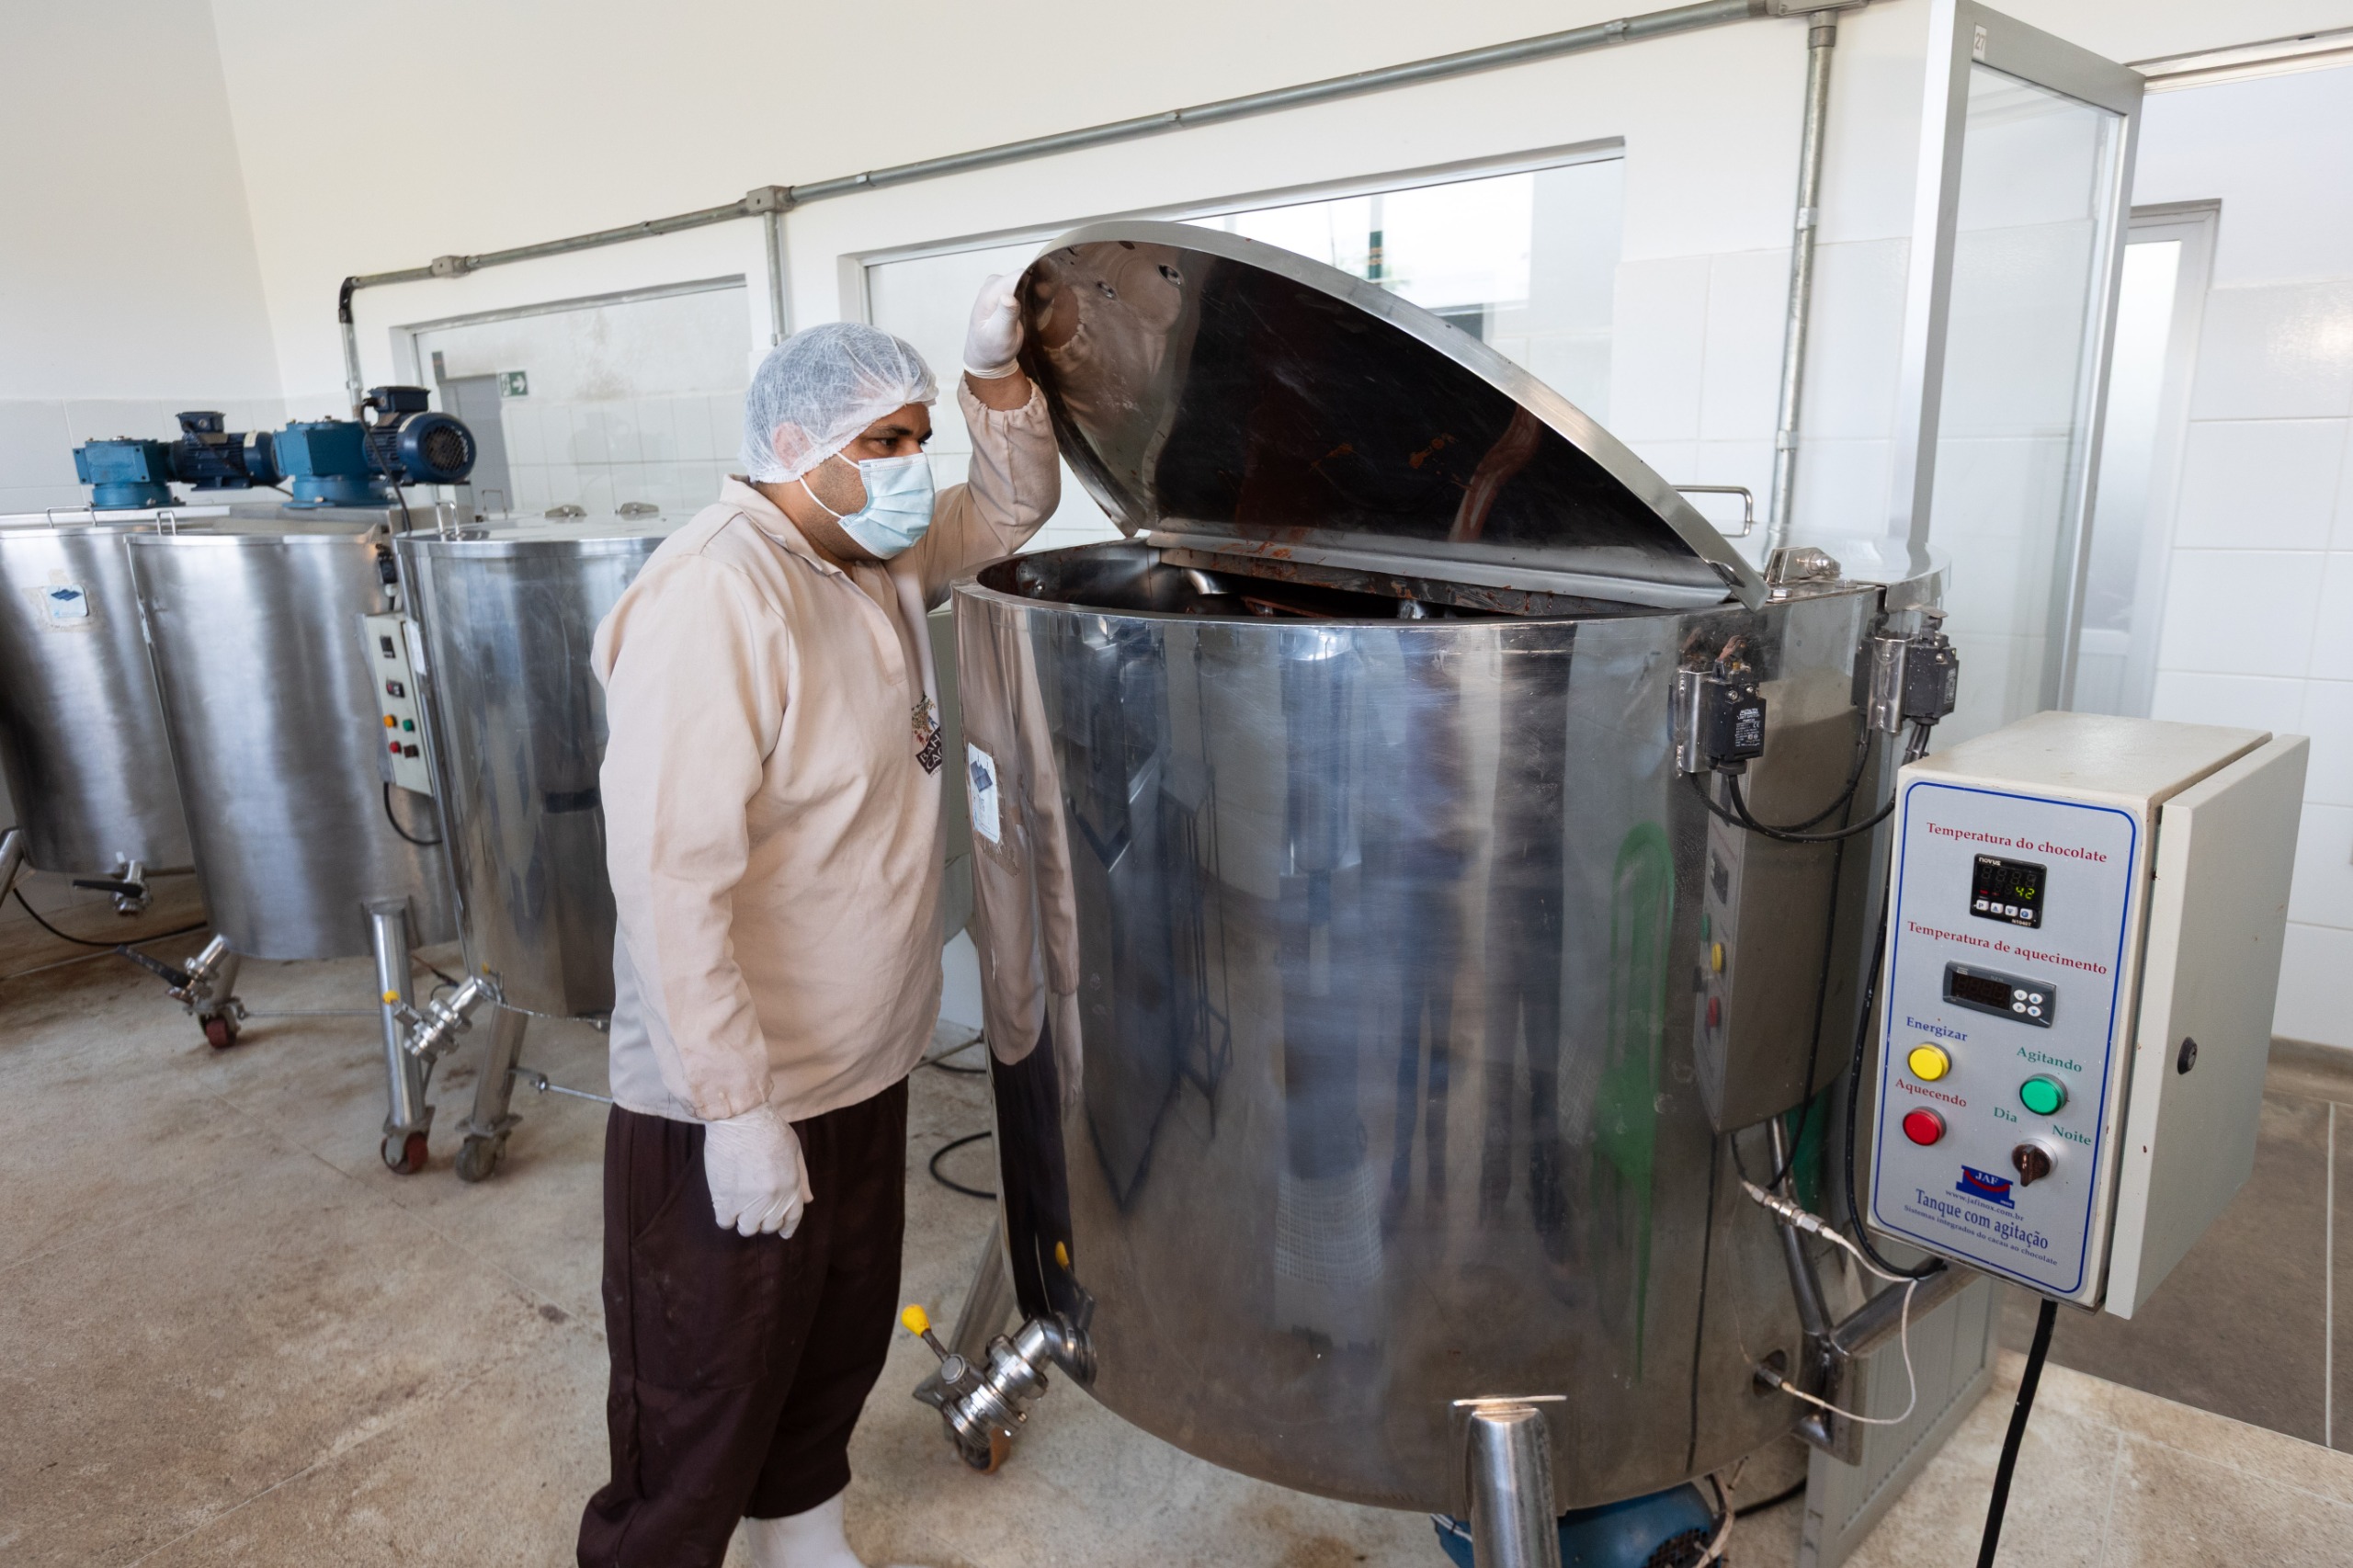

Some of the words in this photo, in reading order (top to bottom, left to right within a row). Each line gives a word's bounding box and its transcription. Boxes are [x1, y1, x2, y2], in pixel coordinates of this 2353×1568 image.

[1974, 32, 1985, 51] 27
[1927, 822, 2012, 846] Temperatura
[2016, 837, 2034, 850] do
[2038, 841, 2108, 863] chocolate
[1978, 857, 2001, 866] novus
[2016, 886, 2035, 900] 42
[1907, 921, 1990, 949] Temperatura
[1994, 940, 2011, 953] de
[2014, 946, 2108, 975] aquecimento
[1906, 1017, 1968, 1041] Energizar
[2017, 1046, 2082, 1073] Agitando
[1895, 1078, 1967, 1108] Aquecendo
[1994, 1107, 2018, 1123] Dia
[2052, 1124, 2091, 1146] Noite
[1975, 1172, 1999, 1185] JAF
[1945, 1190, 2024, 1221] www.jafinox.com.br
[1915, 1188, 1961, 1218] Tanque
[1964, 1210, 1991, 1229] com
[1994, 1220, 2049, 1249] agitação
[1904, 1204, 1936, 1221] Sistemas
[1937, 1214, 1975, 1236] integrados
[1976, 1231, 1987, 1240] do
[1987, 1236, 2008, 1248] cacau
[2009, 1244, 2019, 1252] ao
[2020, 1247, 2058, 1267] chocolate
